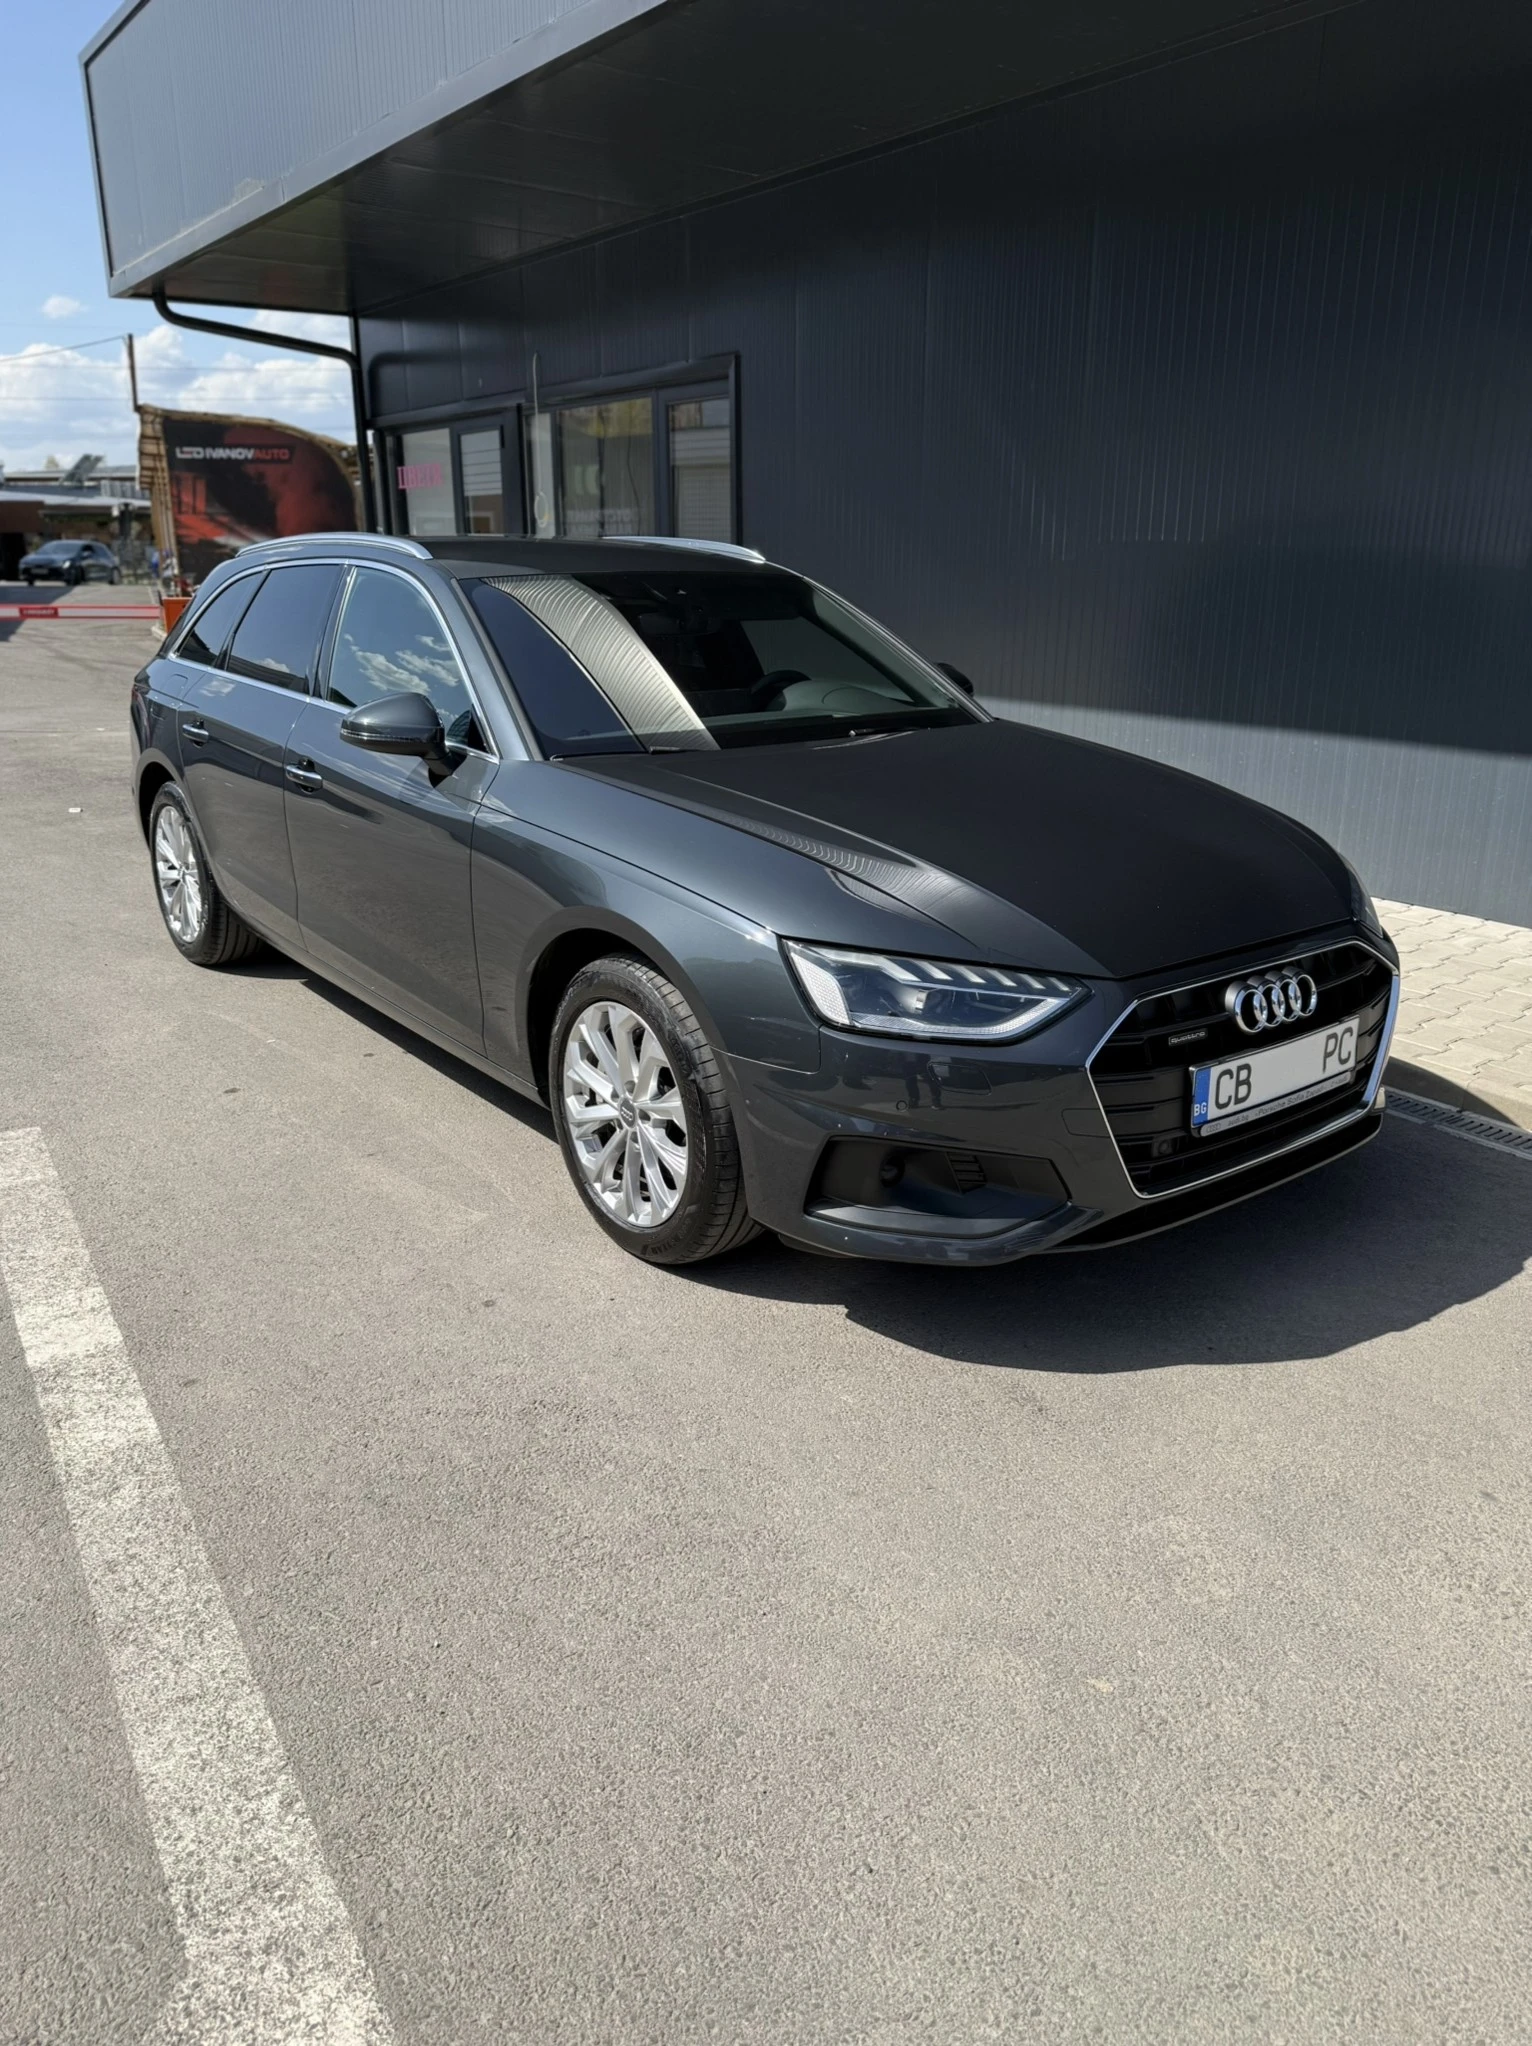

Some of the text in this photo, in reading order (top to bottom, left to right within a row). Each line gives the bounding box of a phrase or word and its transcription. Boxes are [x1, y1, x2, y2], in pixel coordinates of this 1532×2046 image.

[1214, 1027, 1353, 1110] CB PC
[1193, 1102, 1207, 1117] BG
